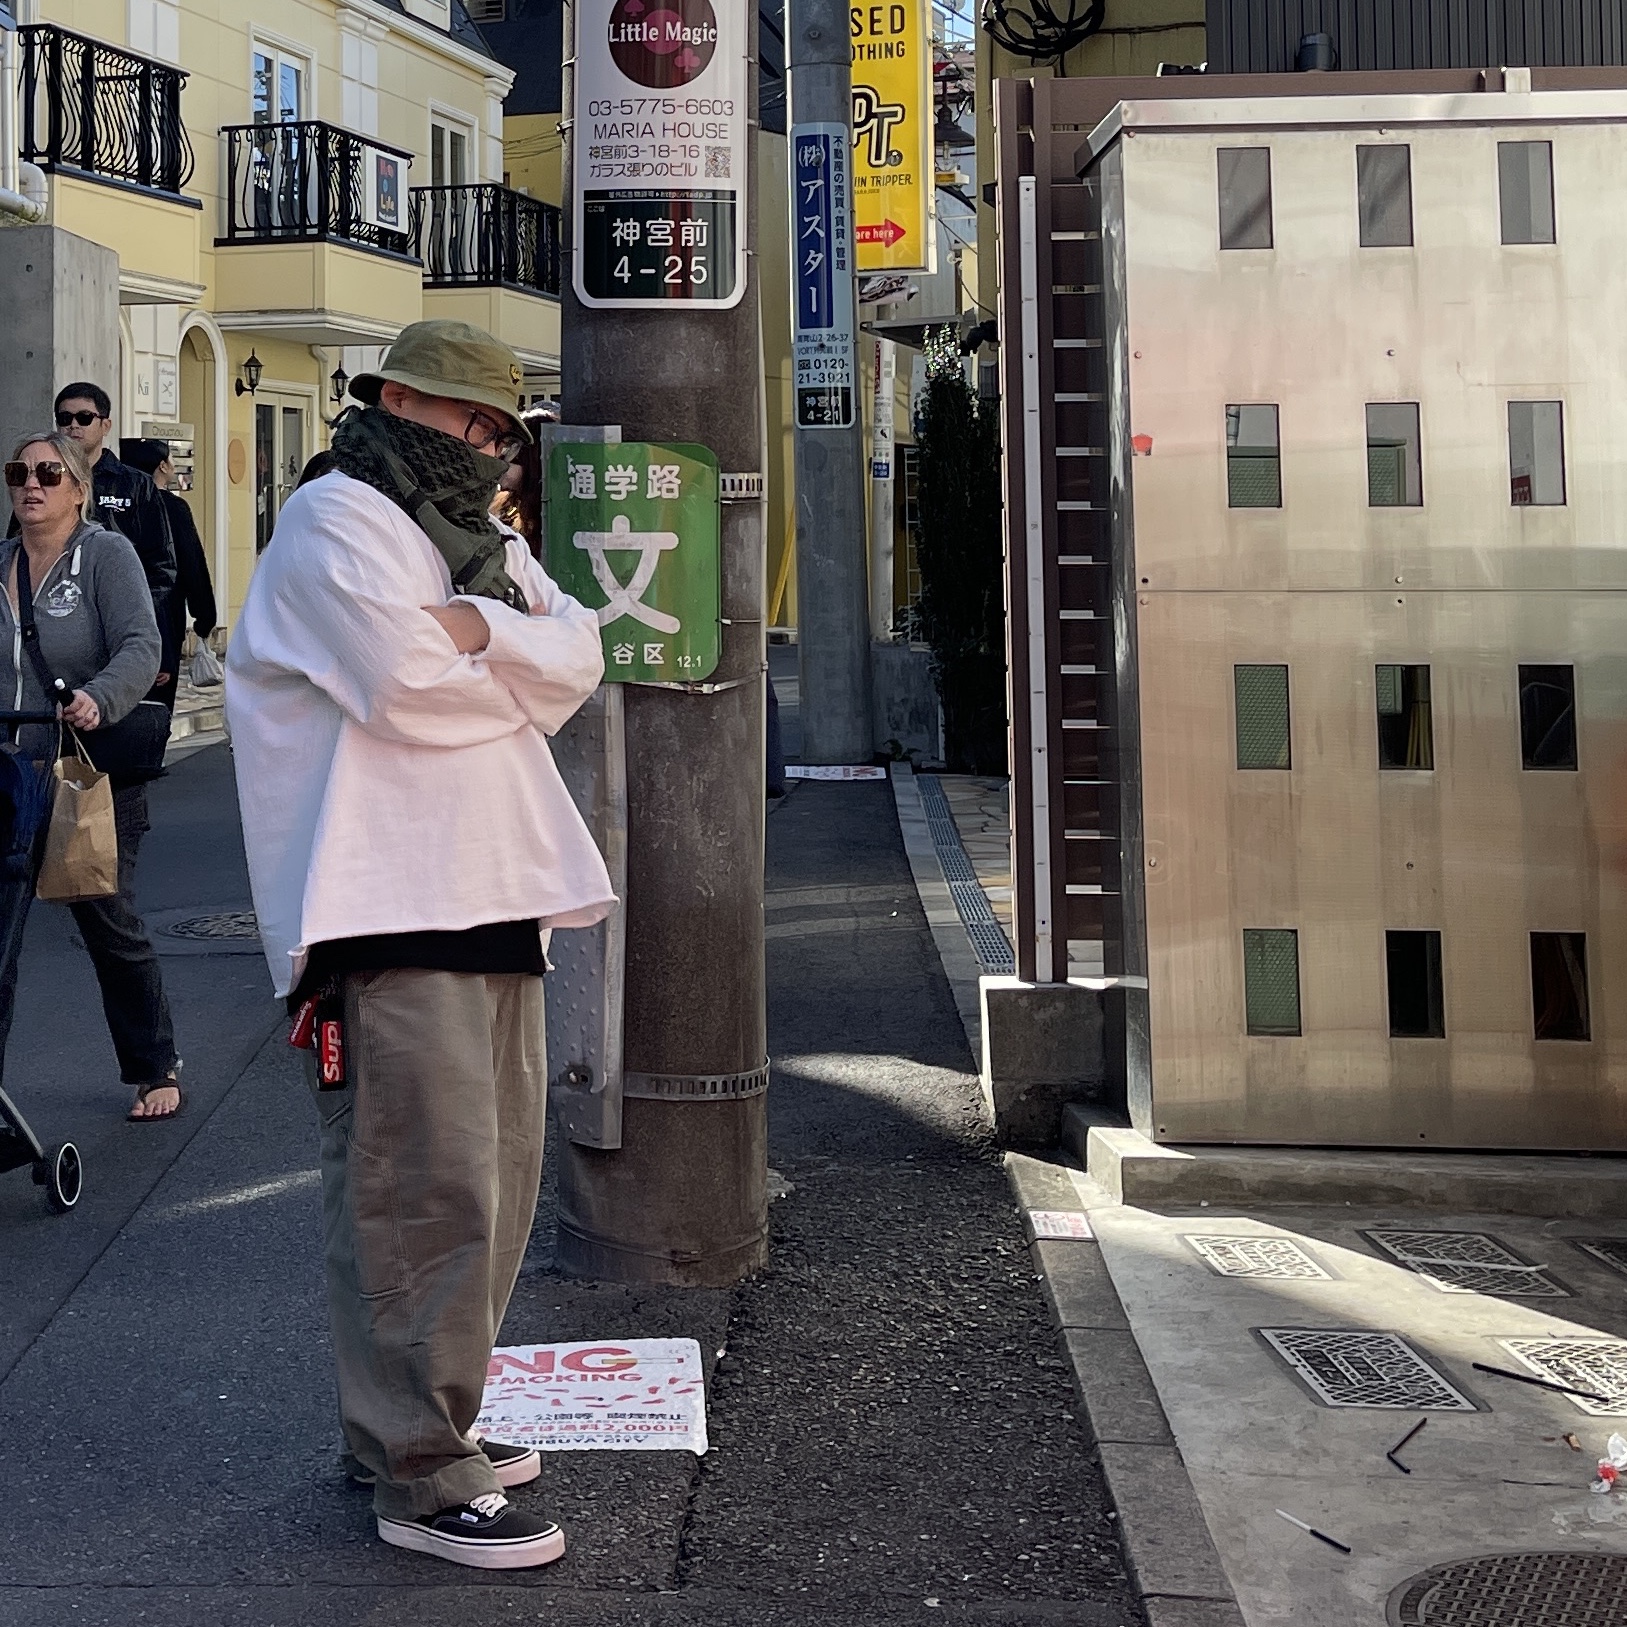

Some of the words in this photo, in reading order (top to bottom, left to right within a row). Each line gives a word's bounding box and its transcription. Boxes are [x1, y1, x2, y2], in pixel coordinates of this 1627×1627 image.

[609, 22, 659, 43] Little
[665, 21, 718, 46] Magic
[588, 98, 735, 117] 03-5775-6603
[593, 122, 656, 140] MARIA
[662, 122, 729, 139] HOUSE
[588, 144, 701, 160] 神宮前3-18-16
[589, 162, 698, 178] ガラス張りのビル
[870, 173, 914, 187] TRIPPER
[612, 217, 709, 248] 神宮前
[872, 228, 894, 239] here
[613, 255, 708, 284] 4-25
[566, 454, 682, 501] 通学路
[612, 642, 665, 665] 谷区
[677, 655, 703, 668] 12.1
